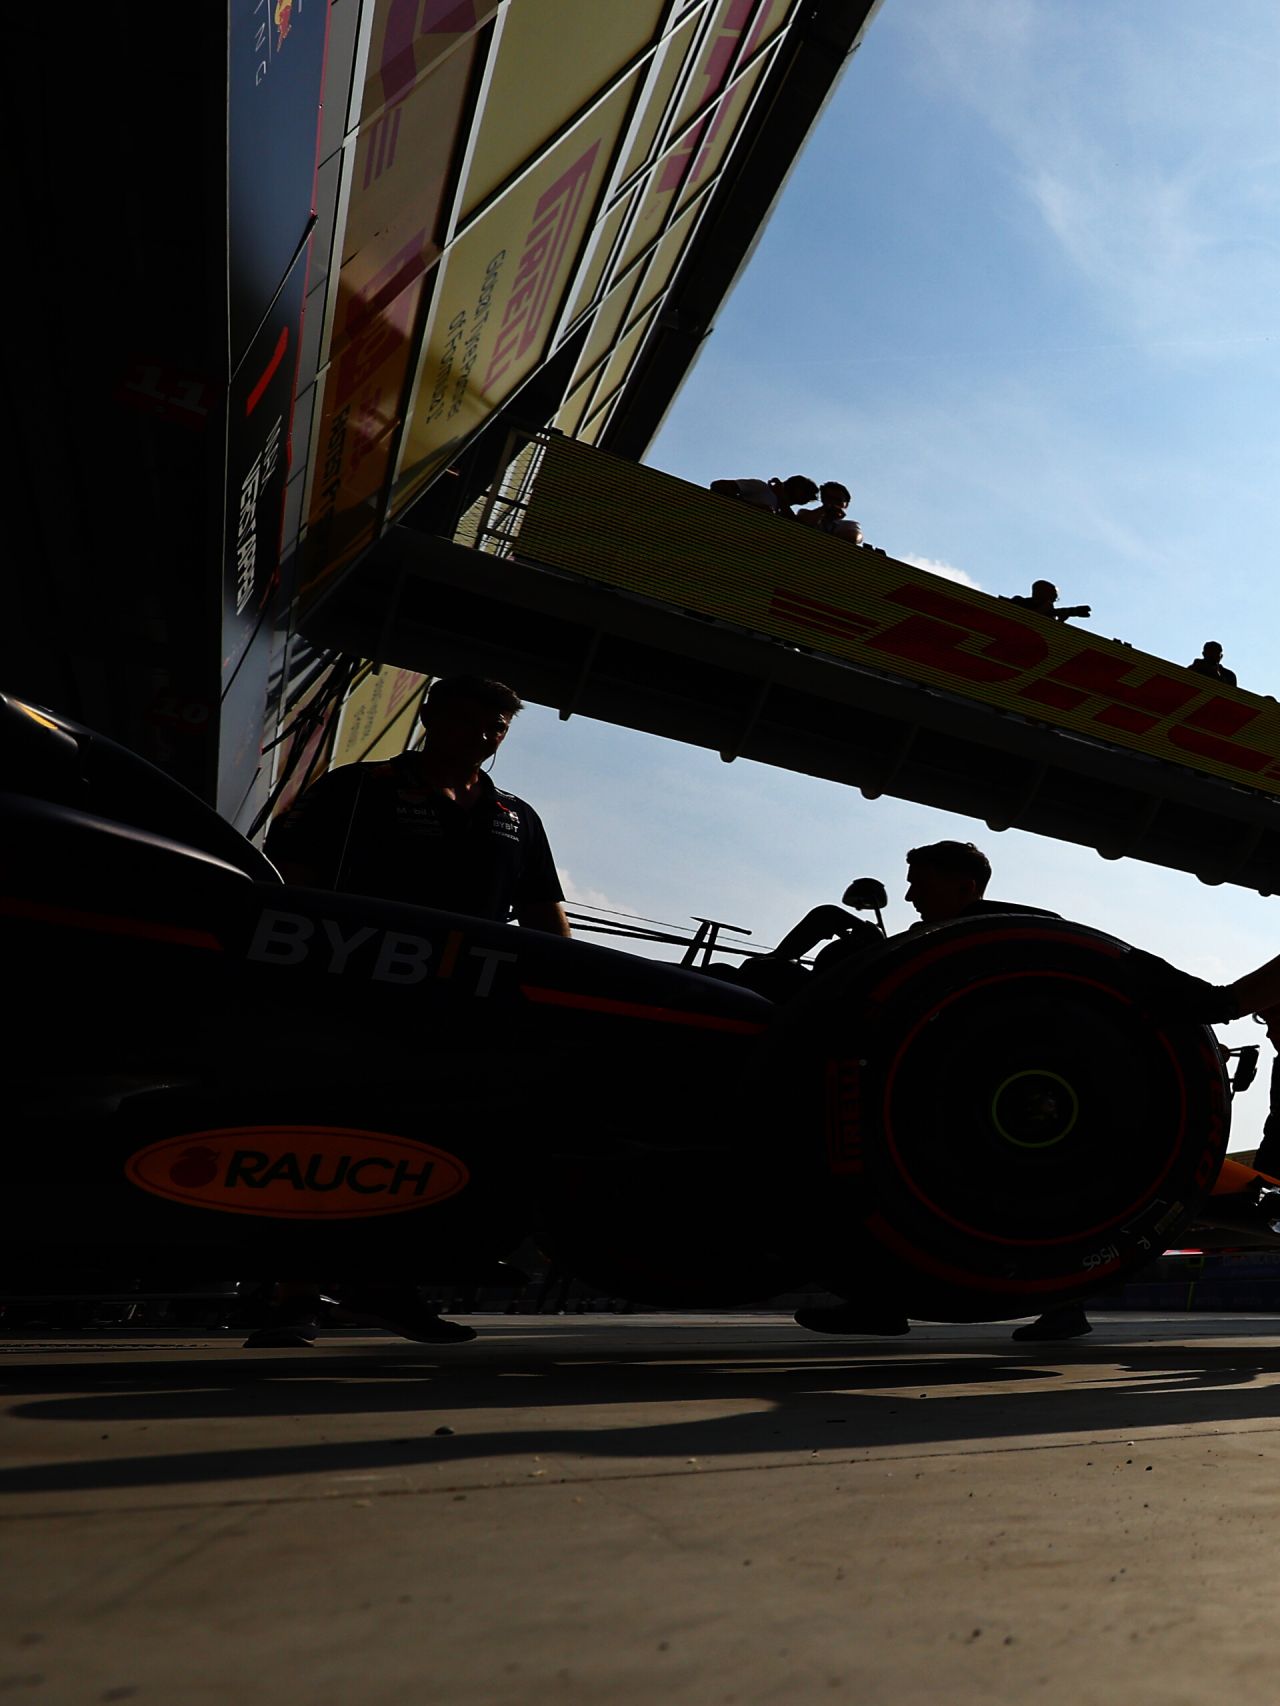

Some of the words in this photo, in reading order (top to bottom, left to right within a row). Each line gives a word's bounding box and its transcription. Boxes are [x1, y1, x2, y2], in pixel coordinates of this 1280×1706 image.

[480, 138, 601, 398] PIRELLI
[123, 364, 209, 417] 11
[235, 450, 264, 616] VERSTAPPEN
[863, 583, 1261, 772] DHL
[246, 907, 519, 999] BYBIT
[226, 1149, 434, 1197] RAUCH
